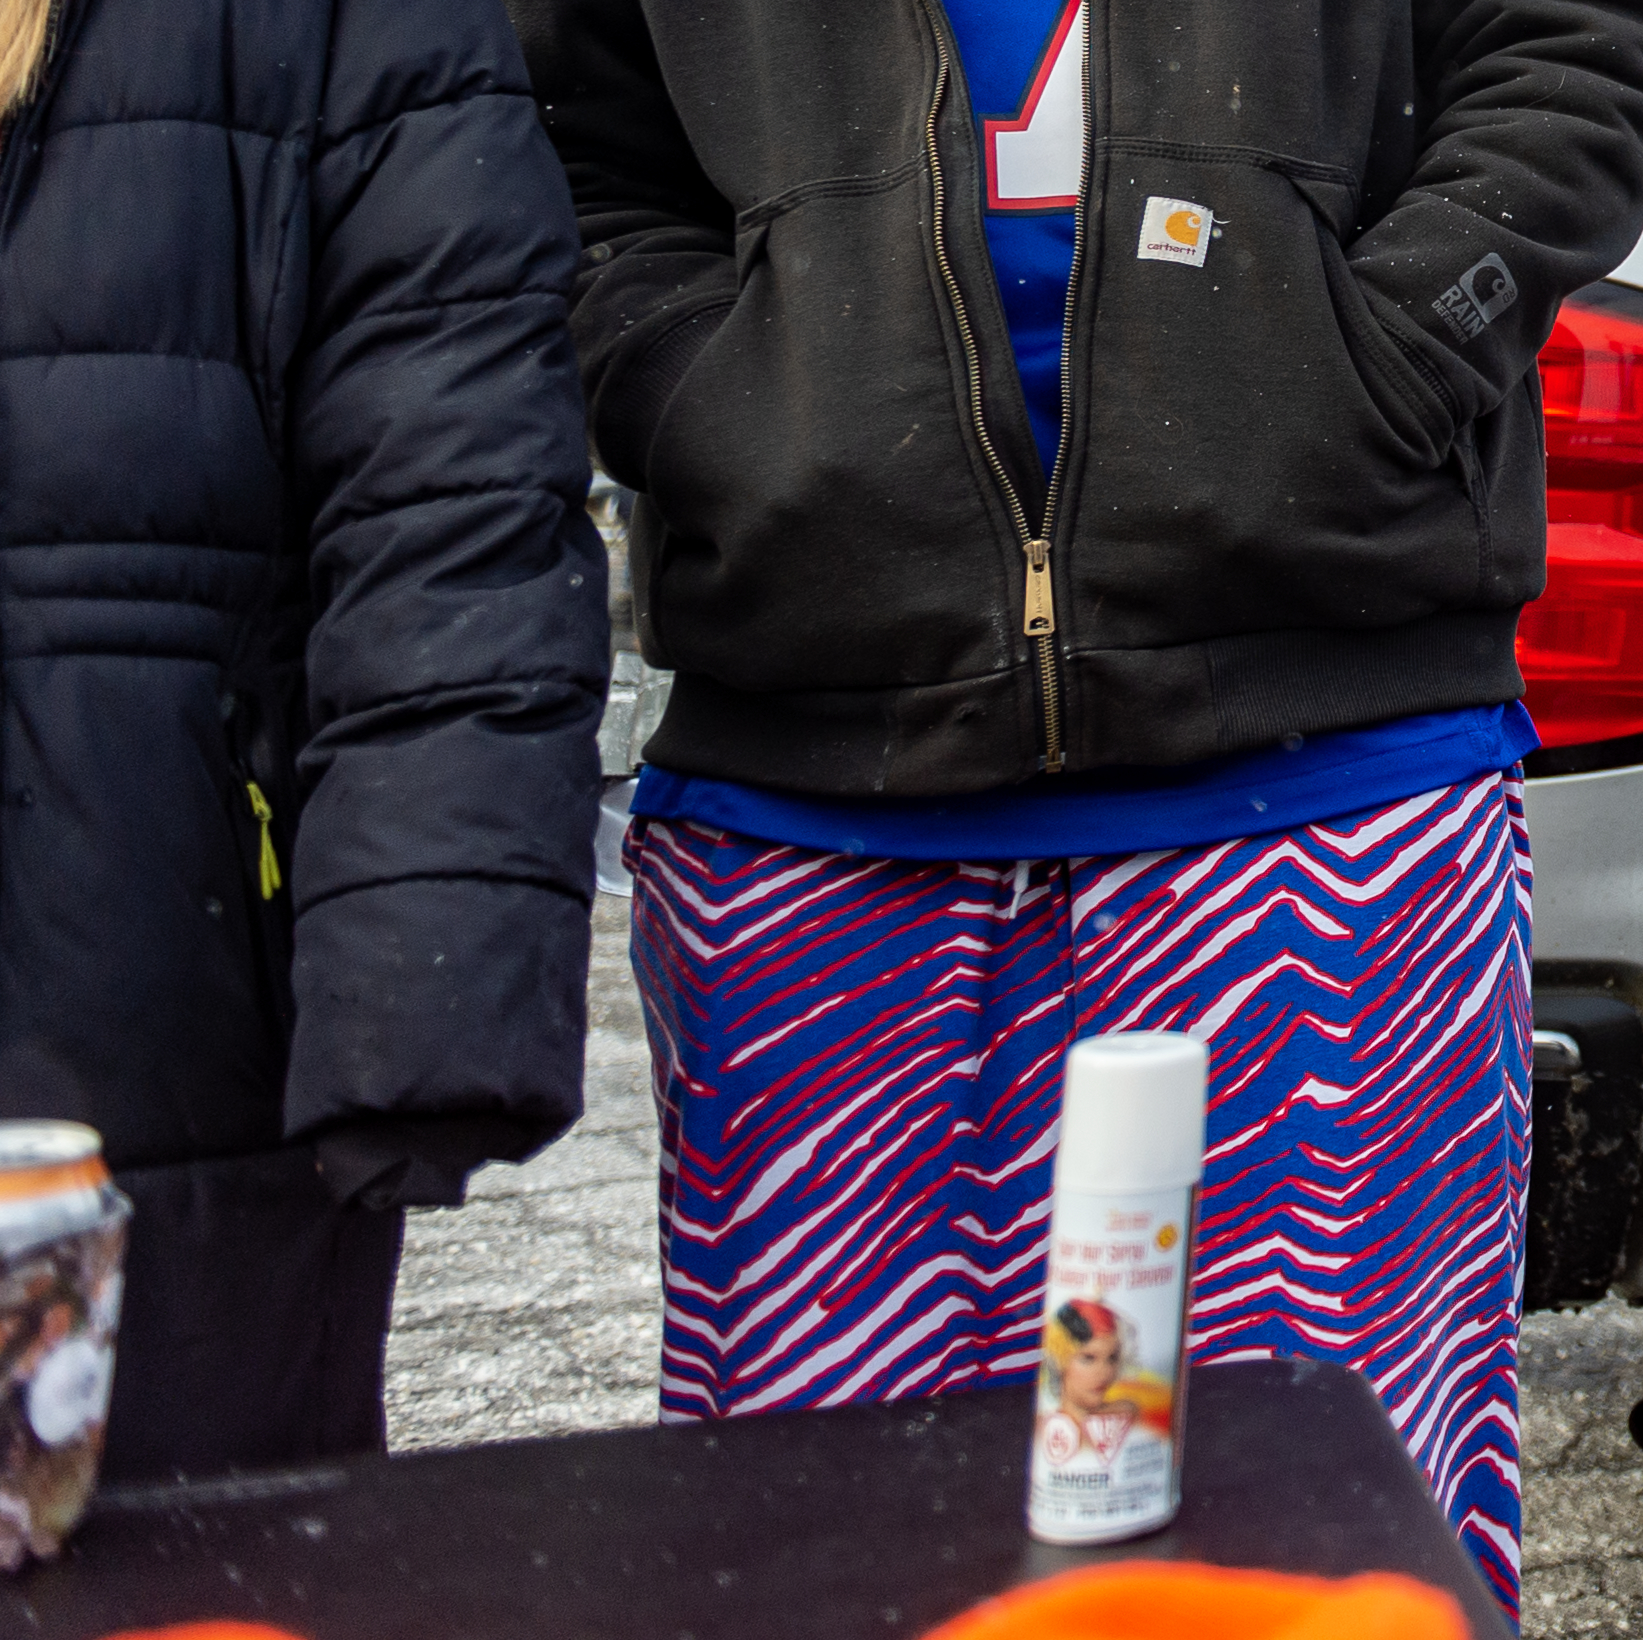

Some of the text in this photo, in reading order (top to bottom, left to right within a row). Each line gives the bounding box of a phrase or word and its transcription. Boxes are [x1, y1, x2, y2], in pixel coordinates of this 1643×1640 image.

[1146, 242, 1197, 256] carhartt
[1432, 300, 1468, 345] DEFENDER
[1440, 285, 1485, 339] RAIN
